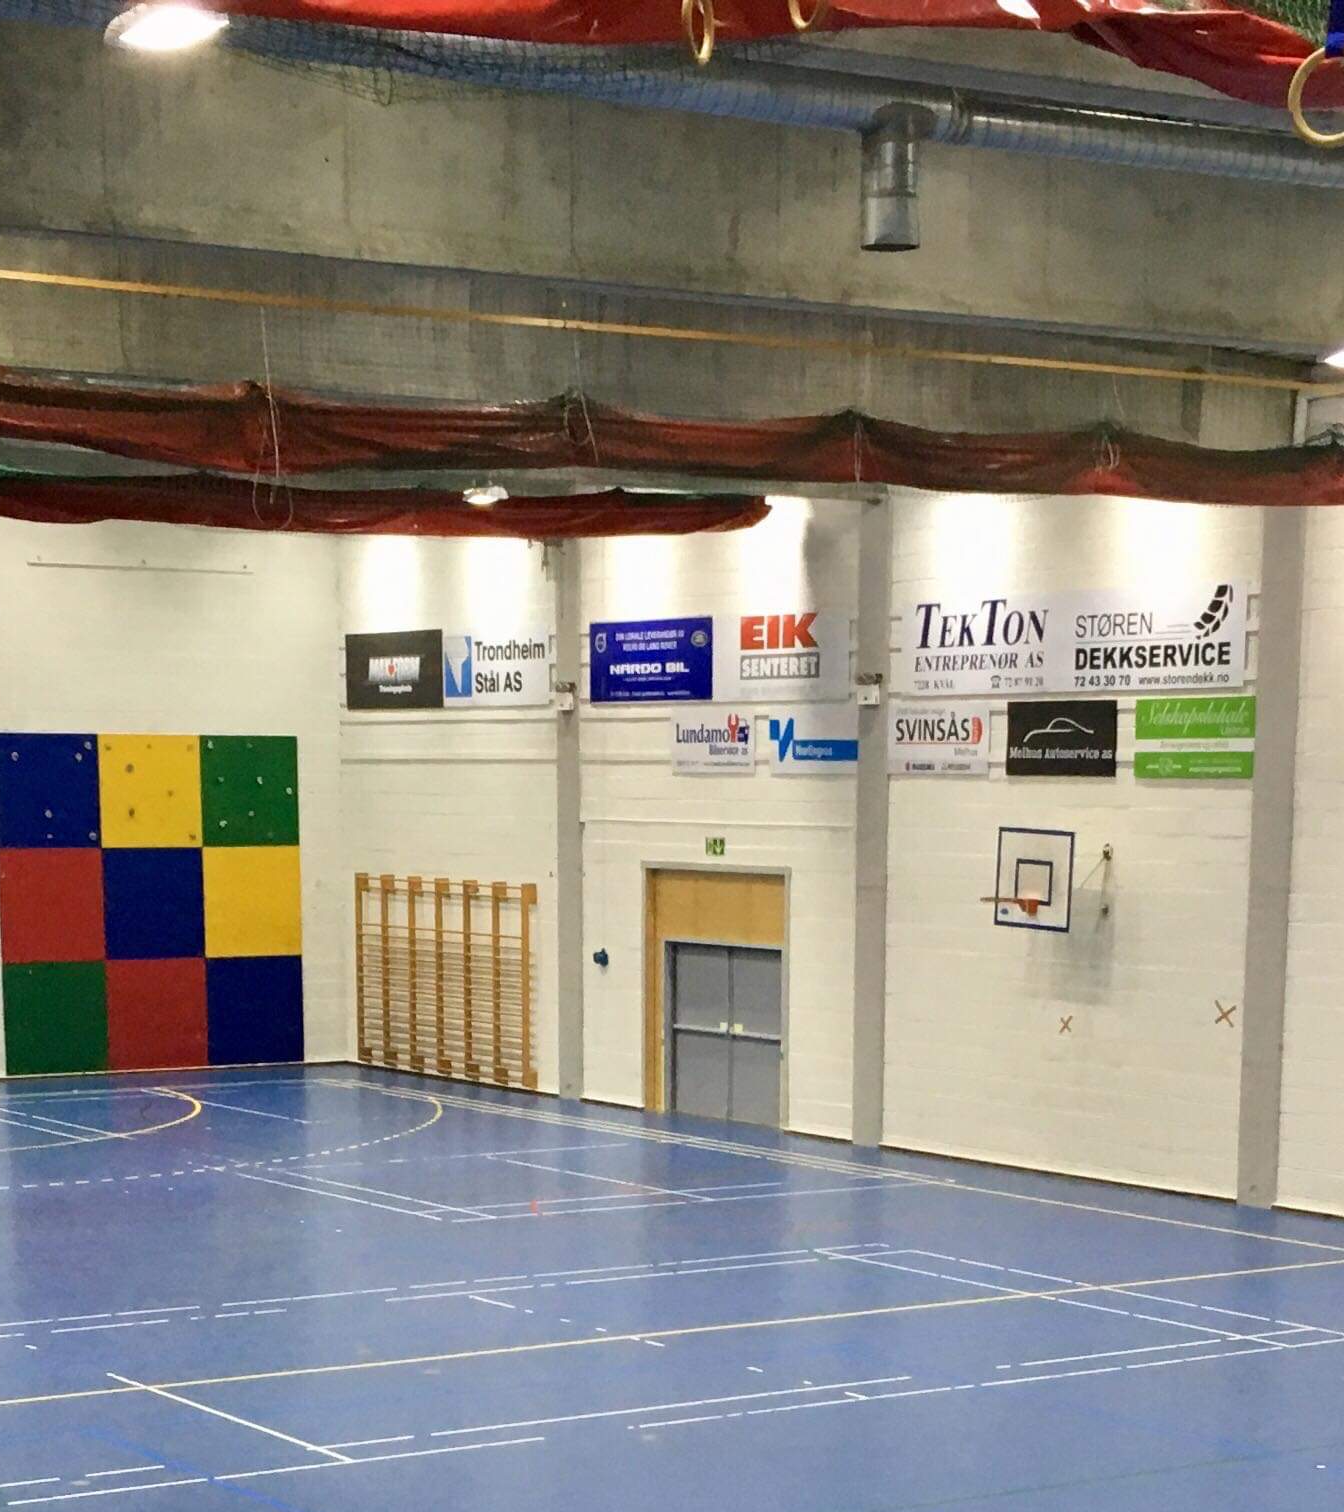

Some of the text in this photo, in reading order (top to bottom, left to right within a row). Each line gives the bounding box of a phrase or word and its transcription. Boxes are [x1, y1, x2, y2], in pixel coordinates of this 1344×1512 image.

[740, 612, 819, 650] EIK
[1075, 612, 1153, 638] STØREN
[475, 638, 545, 662] Trondheim
[914, 651, 1044, 672] ENTREPRENØR AS
[1074, 642, 1231, 670] DEKKSERVICE
[665, 662, 690, 673] BIL
[741, 656, 818, 677] SENTERET
[475, 670, 523, 693] Stål AS
[1074, 675, 1086, 687] 72
[1088, 675, 1101, 686] 43
[1103, 675, 1116, 686] 30
[1119, 674, 1131, 686] 70
[676, 723, 730, 744] Lundamo
[895, 711, 970, 742] SVINSÅS
